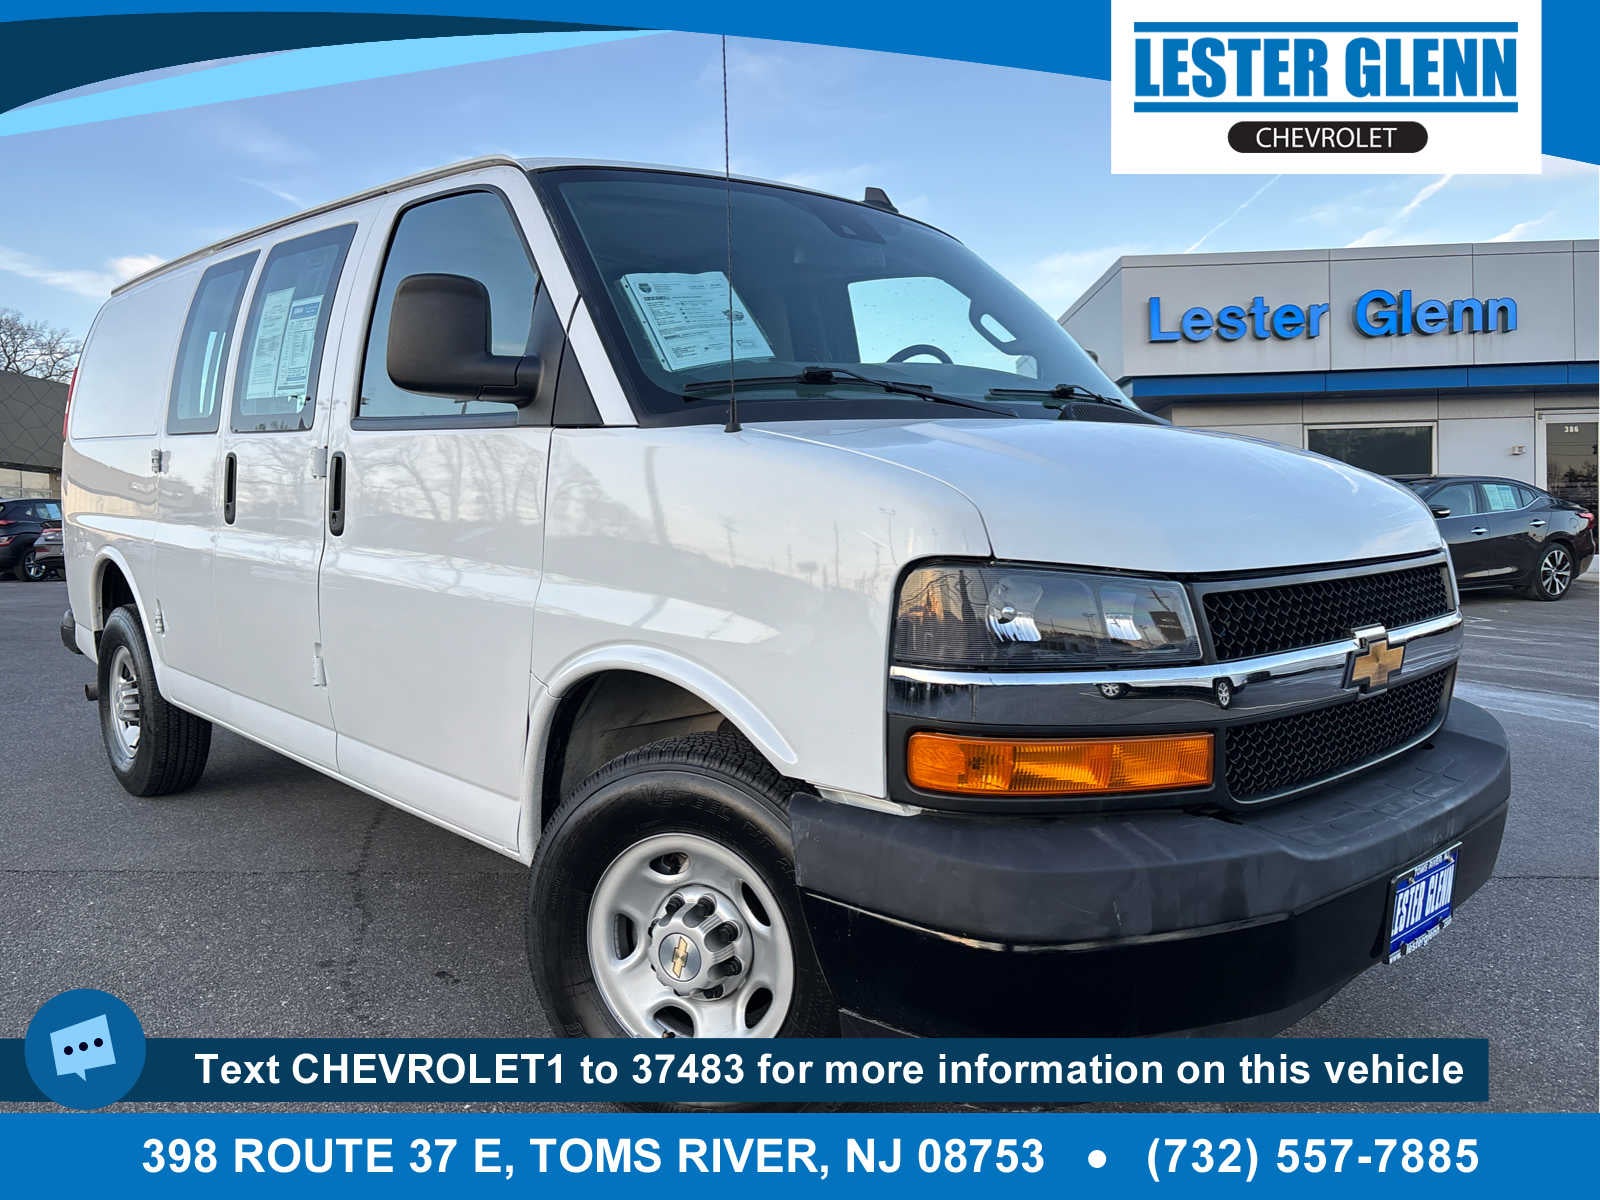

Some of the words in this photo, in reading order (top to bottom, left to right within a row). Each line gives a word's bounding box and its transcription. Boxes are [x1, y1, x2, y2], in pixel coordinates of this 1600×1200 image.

[1148, 296, 1329, 343] Lester
[1353, 289, 1518, 337] Glenn
[1425, 863, 1455, 917] GLENN
